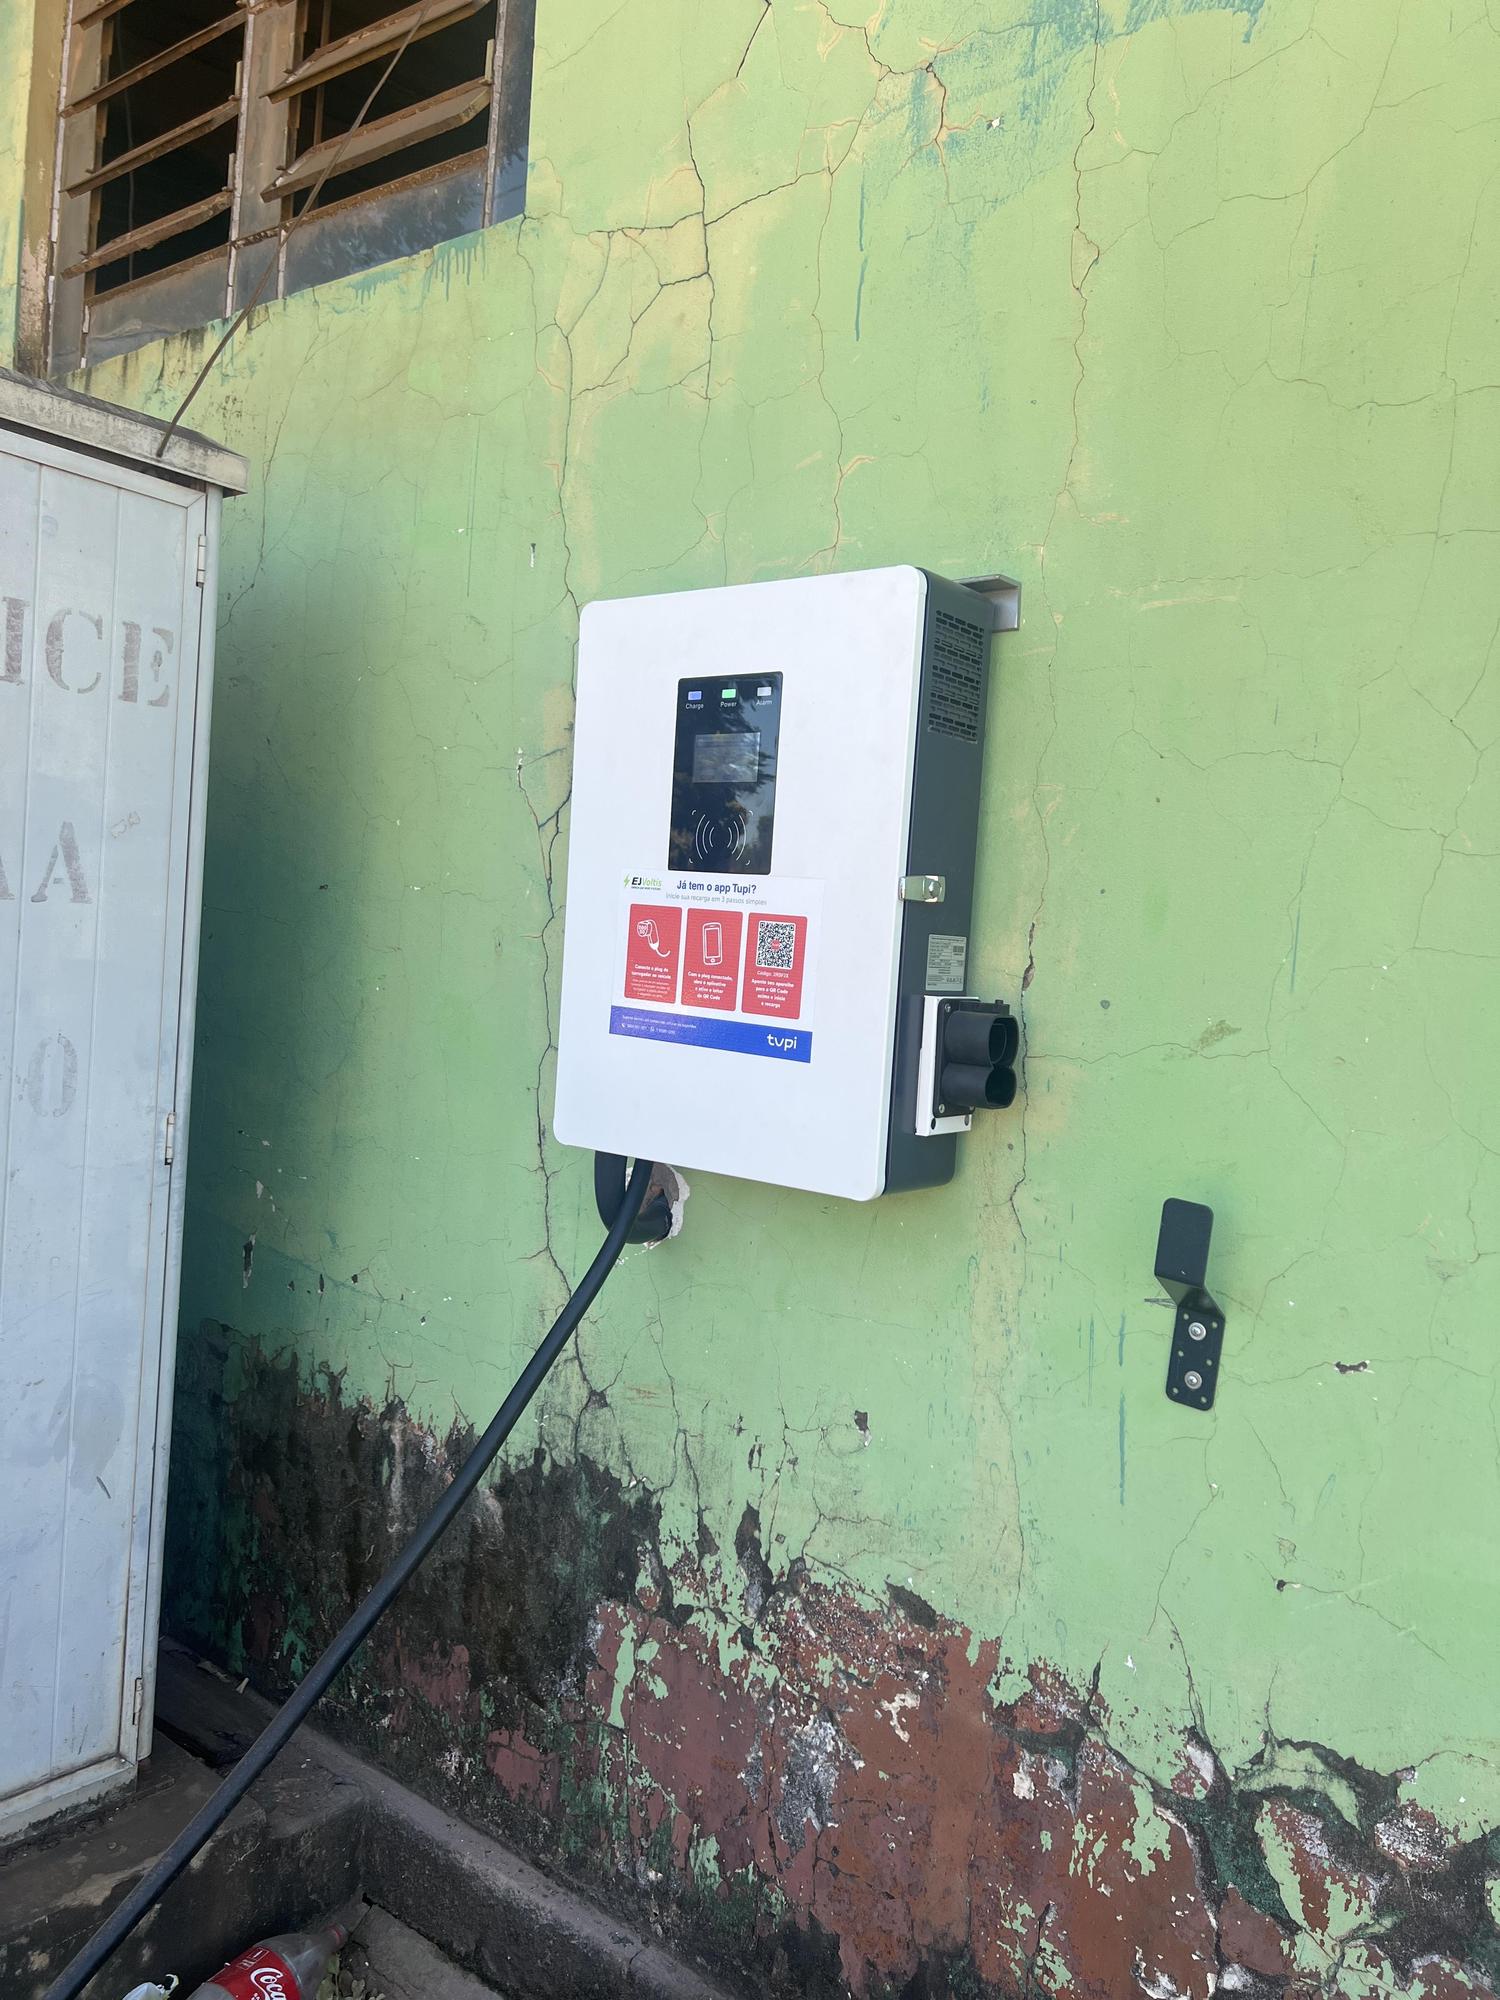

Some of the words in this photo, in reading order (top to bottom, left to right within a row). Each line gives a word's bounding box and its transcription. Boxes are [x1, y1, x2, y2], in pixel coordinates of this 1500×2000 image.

[677, 880, 687, 890] Já
[689, 881, 704, 891] tem
[707, 884, 713, 892] o
[714, 884, 731, 894] app
[732, 883, 757, 895] Tupi?
